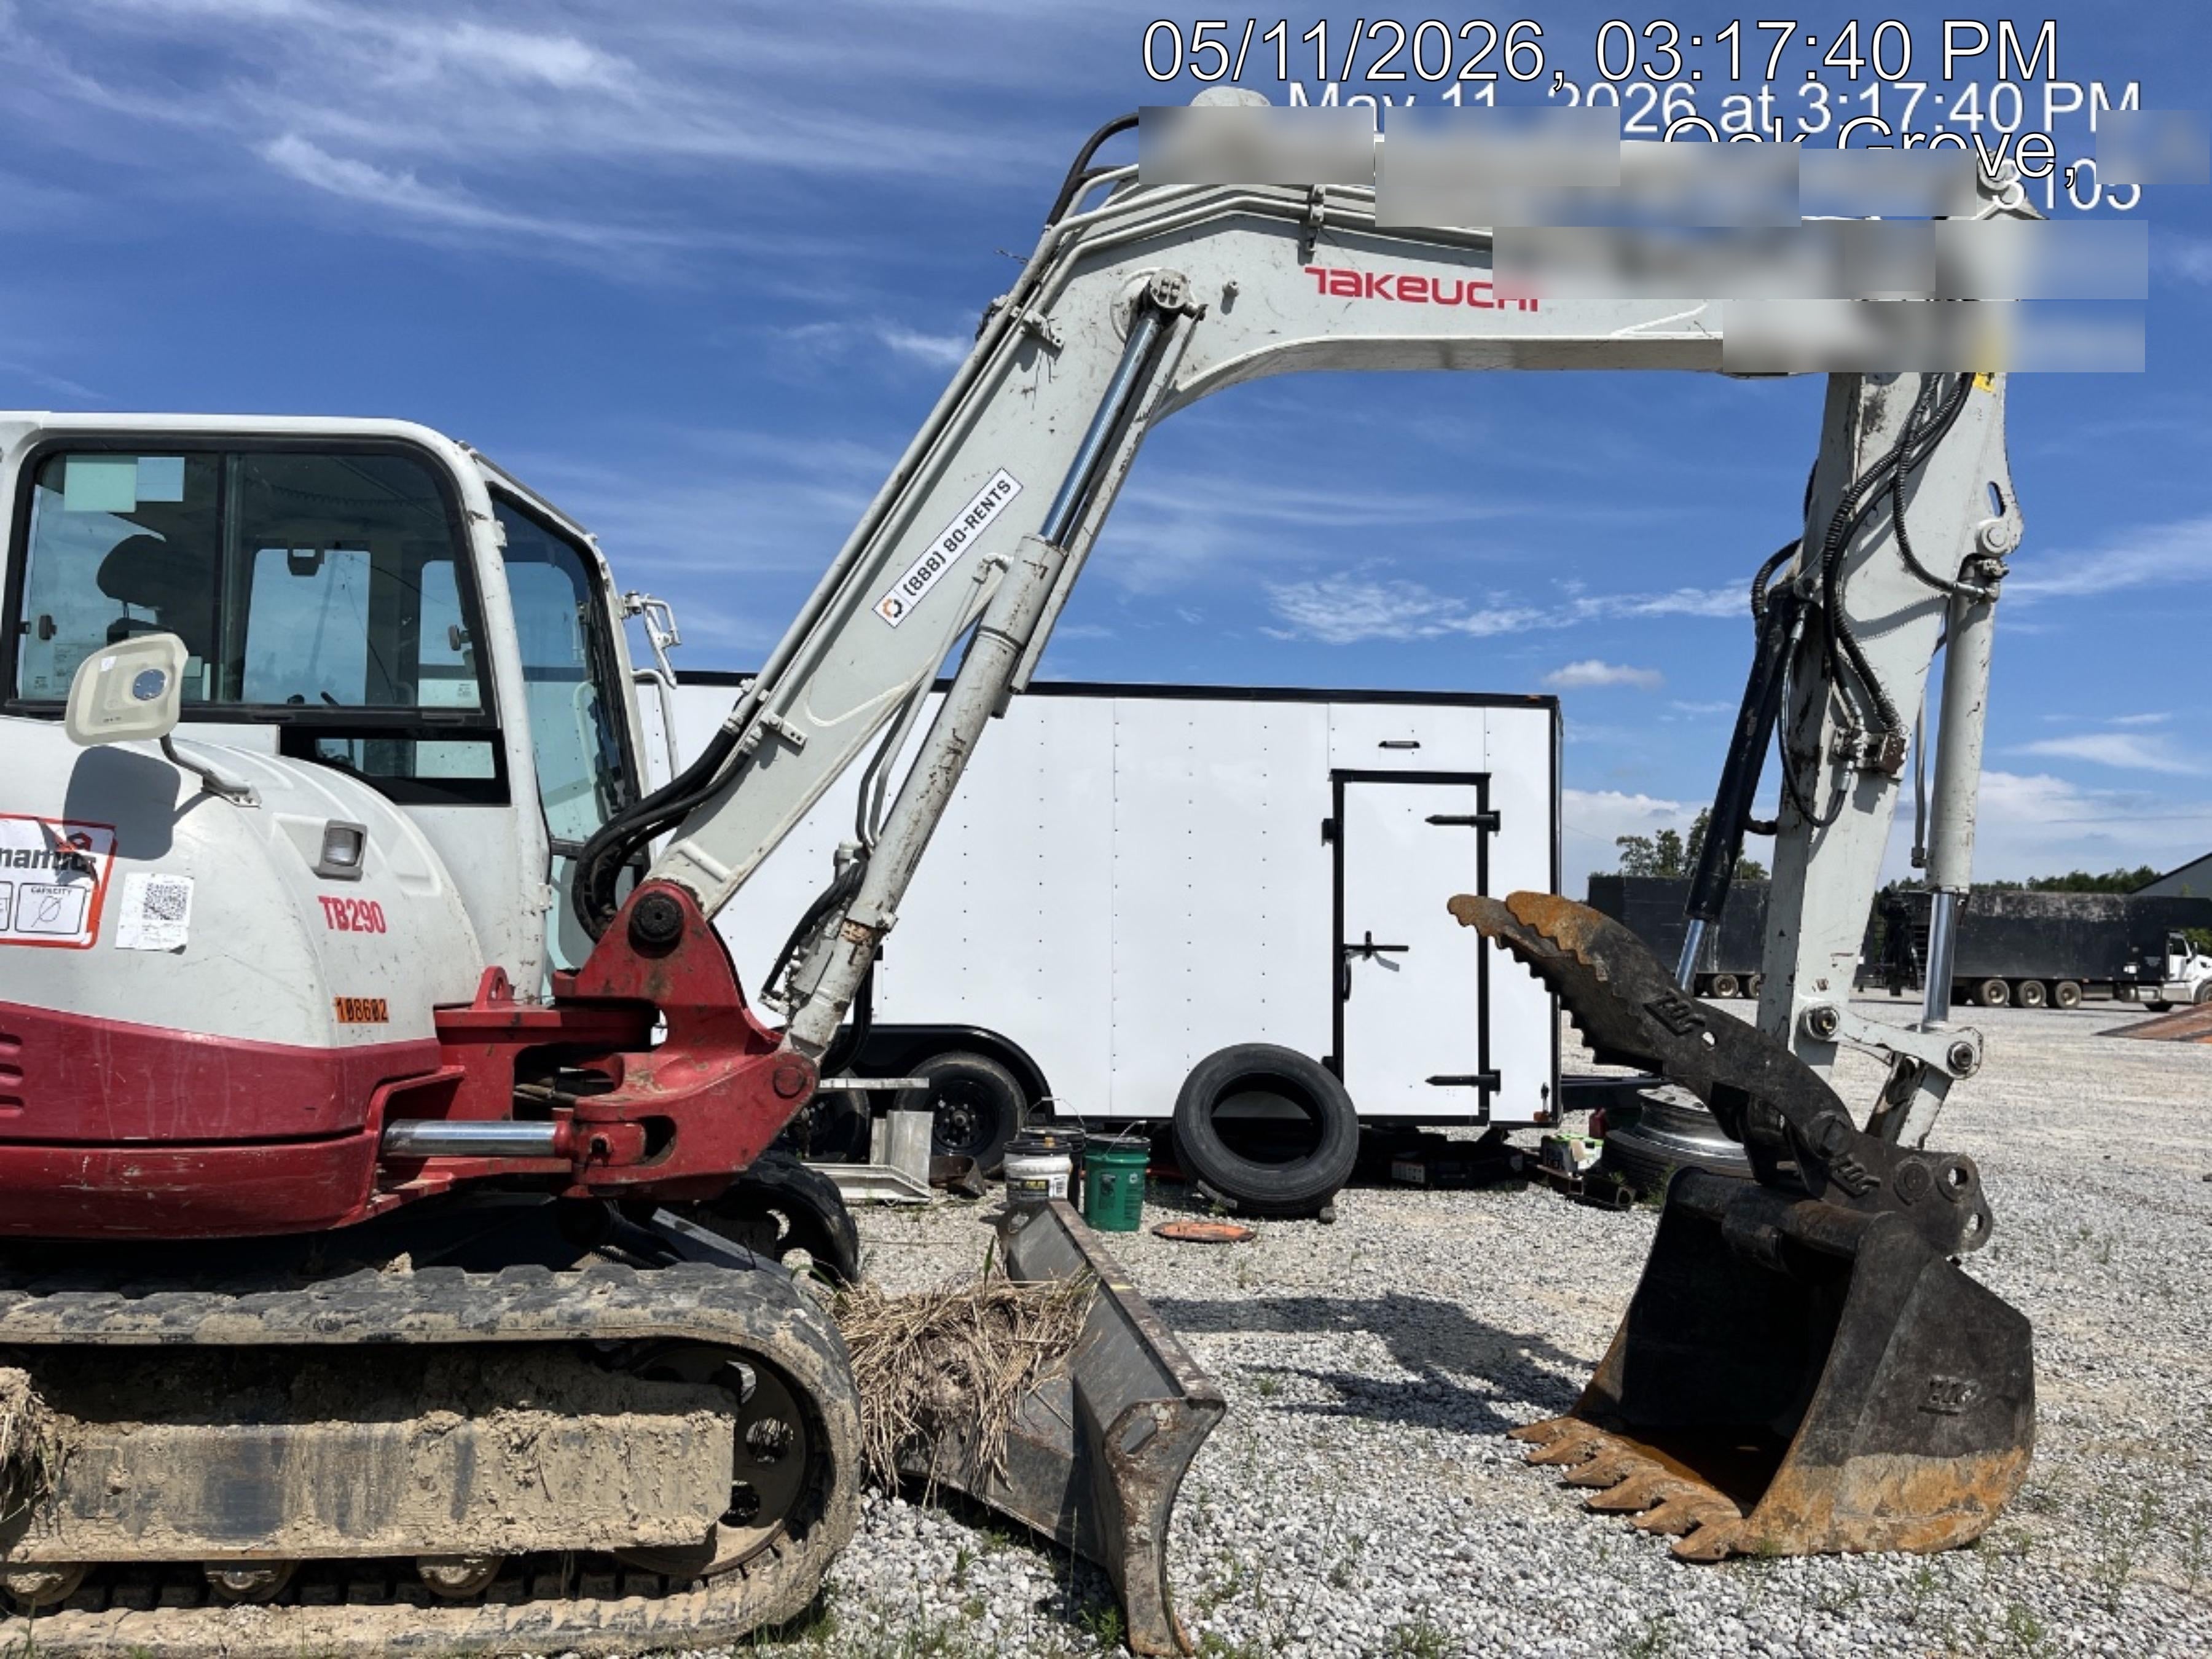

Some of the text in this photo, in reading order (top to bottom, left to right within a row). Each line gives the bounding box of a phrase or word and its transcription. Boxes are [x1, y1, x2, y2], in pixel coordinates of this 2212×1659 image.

[903, 479, 1011, 597] (888) 80-RENTS
[317, 895, 386, 933] TB290
